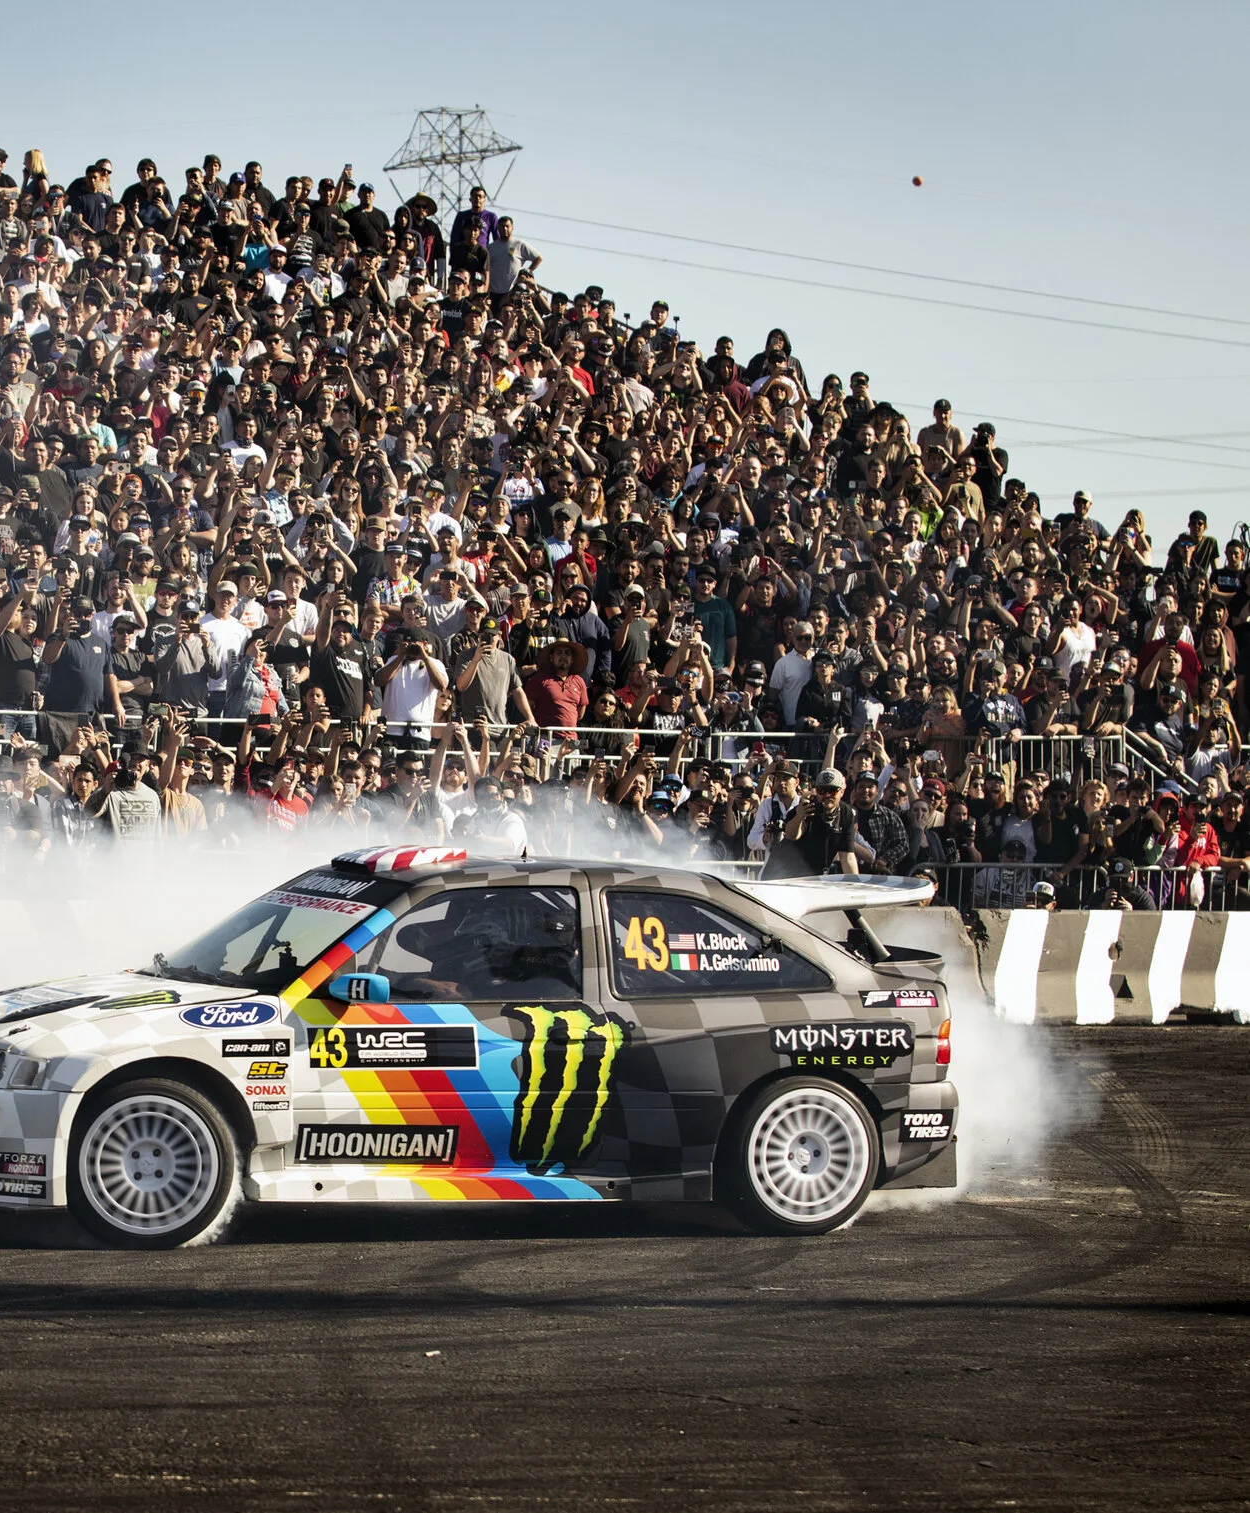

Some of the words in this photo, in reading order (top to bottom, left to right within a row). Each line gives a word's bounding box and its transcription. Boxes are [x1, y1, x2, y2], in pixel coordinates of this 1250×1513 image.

[278, 893, 368, 915] PERFORMANCE
[624, 916, 669, 972] 43
[696, 933, 748, 951] K.Block
[893, 990, 935, 998] FORZA
[200, 1003, 259, 1025] Ford
[225, 1044, 270, 1052] can-am
[310, 1028, 348, 1068] 43
[356, 1031, 427, 1049] WRC
[797, 1056, 890, 1065] ENERGY
[245, 1085, 286, 1096] SONAX
[253, 1101, 289, 1110] fifteen52
[904, 1113, 943, 1126] TOYO
[909, 1125, 949, 1138] TIRES
[4, 1153, 45, 1165] FORZA
[8, 1163, 39, 1174] HORIZON
[3, 1182, 43, 1195] TIRES
